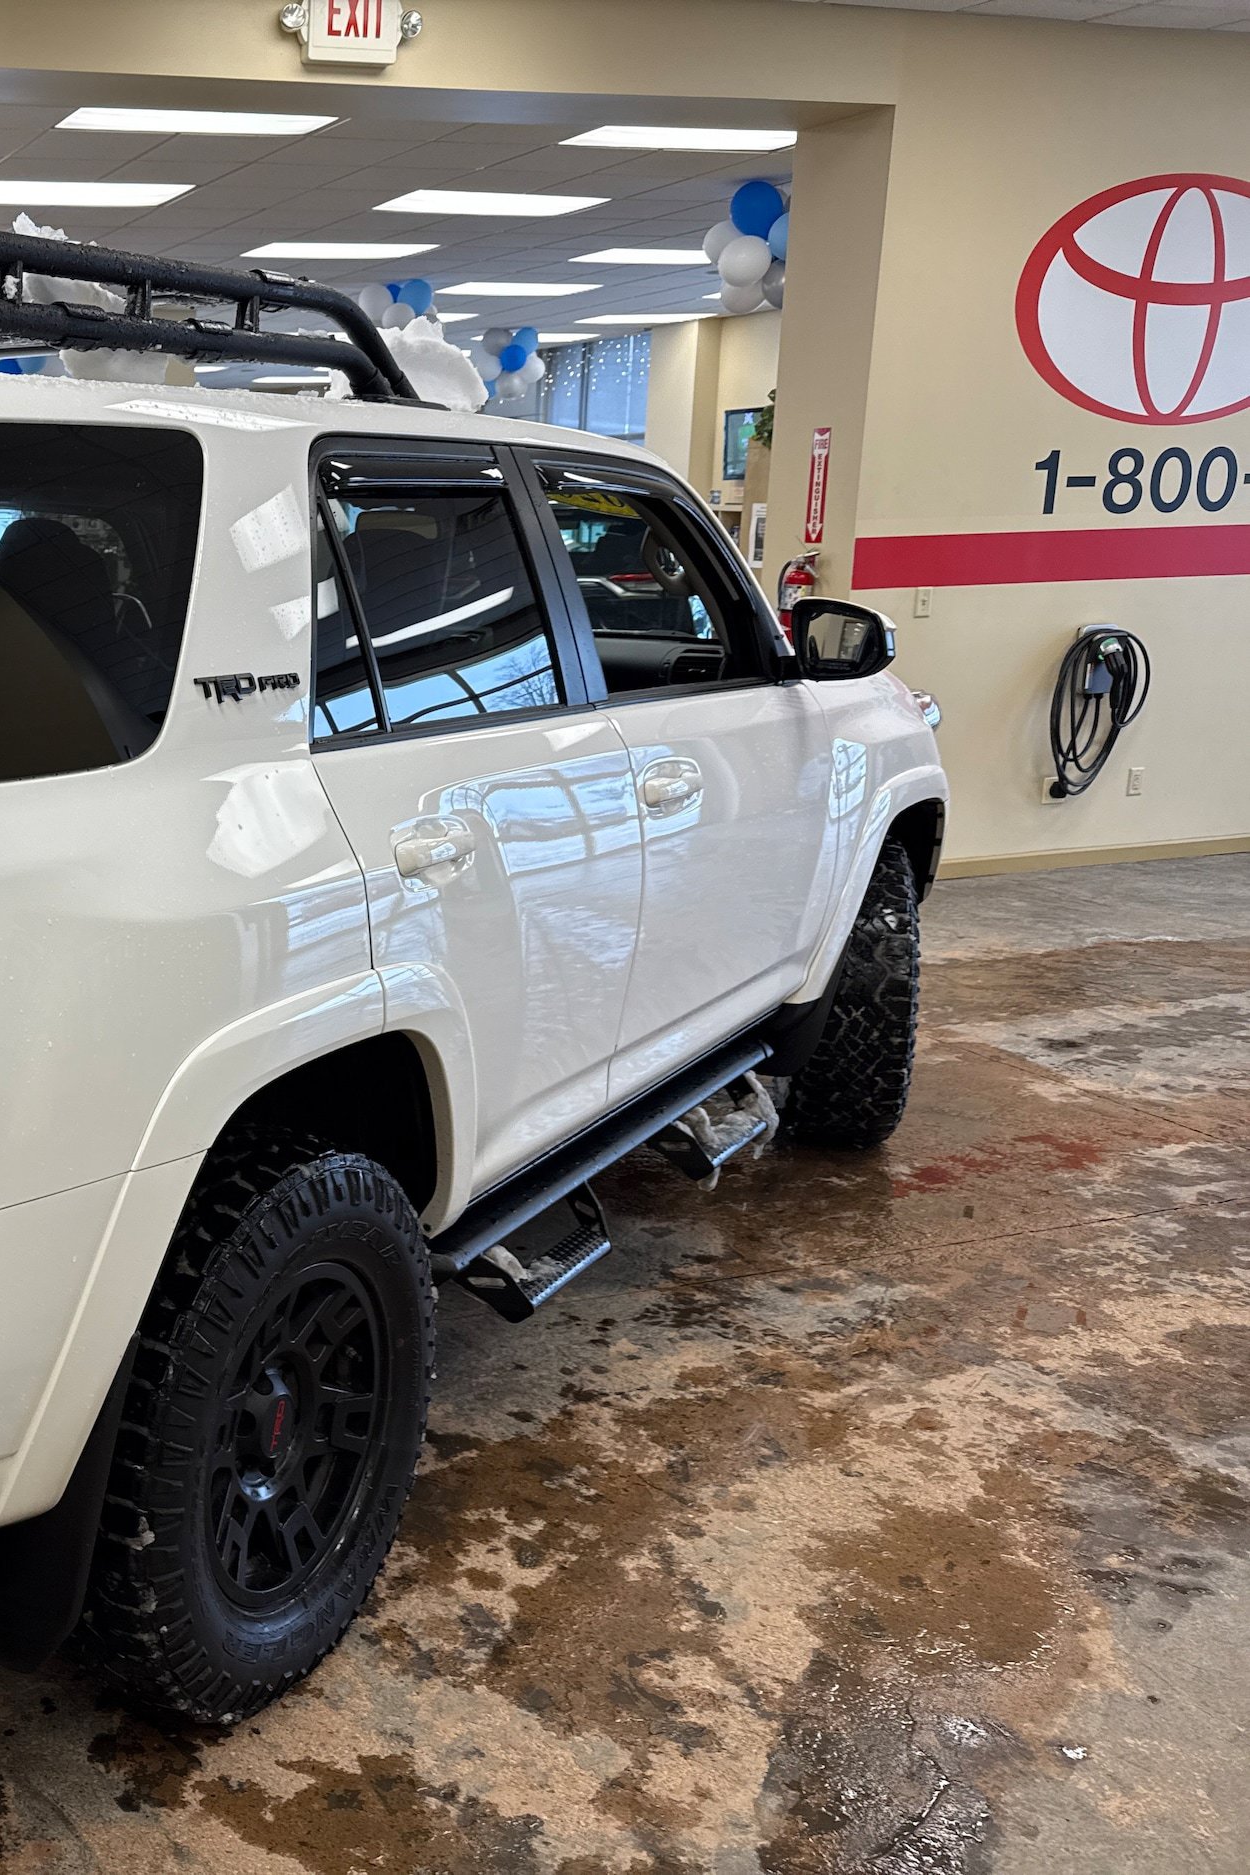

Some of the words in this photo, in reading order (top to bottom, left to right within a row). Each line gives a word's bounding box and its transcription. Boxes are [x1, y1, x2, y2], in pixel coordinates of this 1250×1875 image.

[327, 0, 382, 38] EXIT
[814, 438, 829, 449] FIRE
[811, 453, 823, 534] EXTINGUISHER
[1034, 446, 1250, 514] 1-800
[193, 672, 257, 704] TRD
